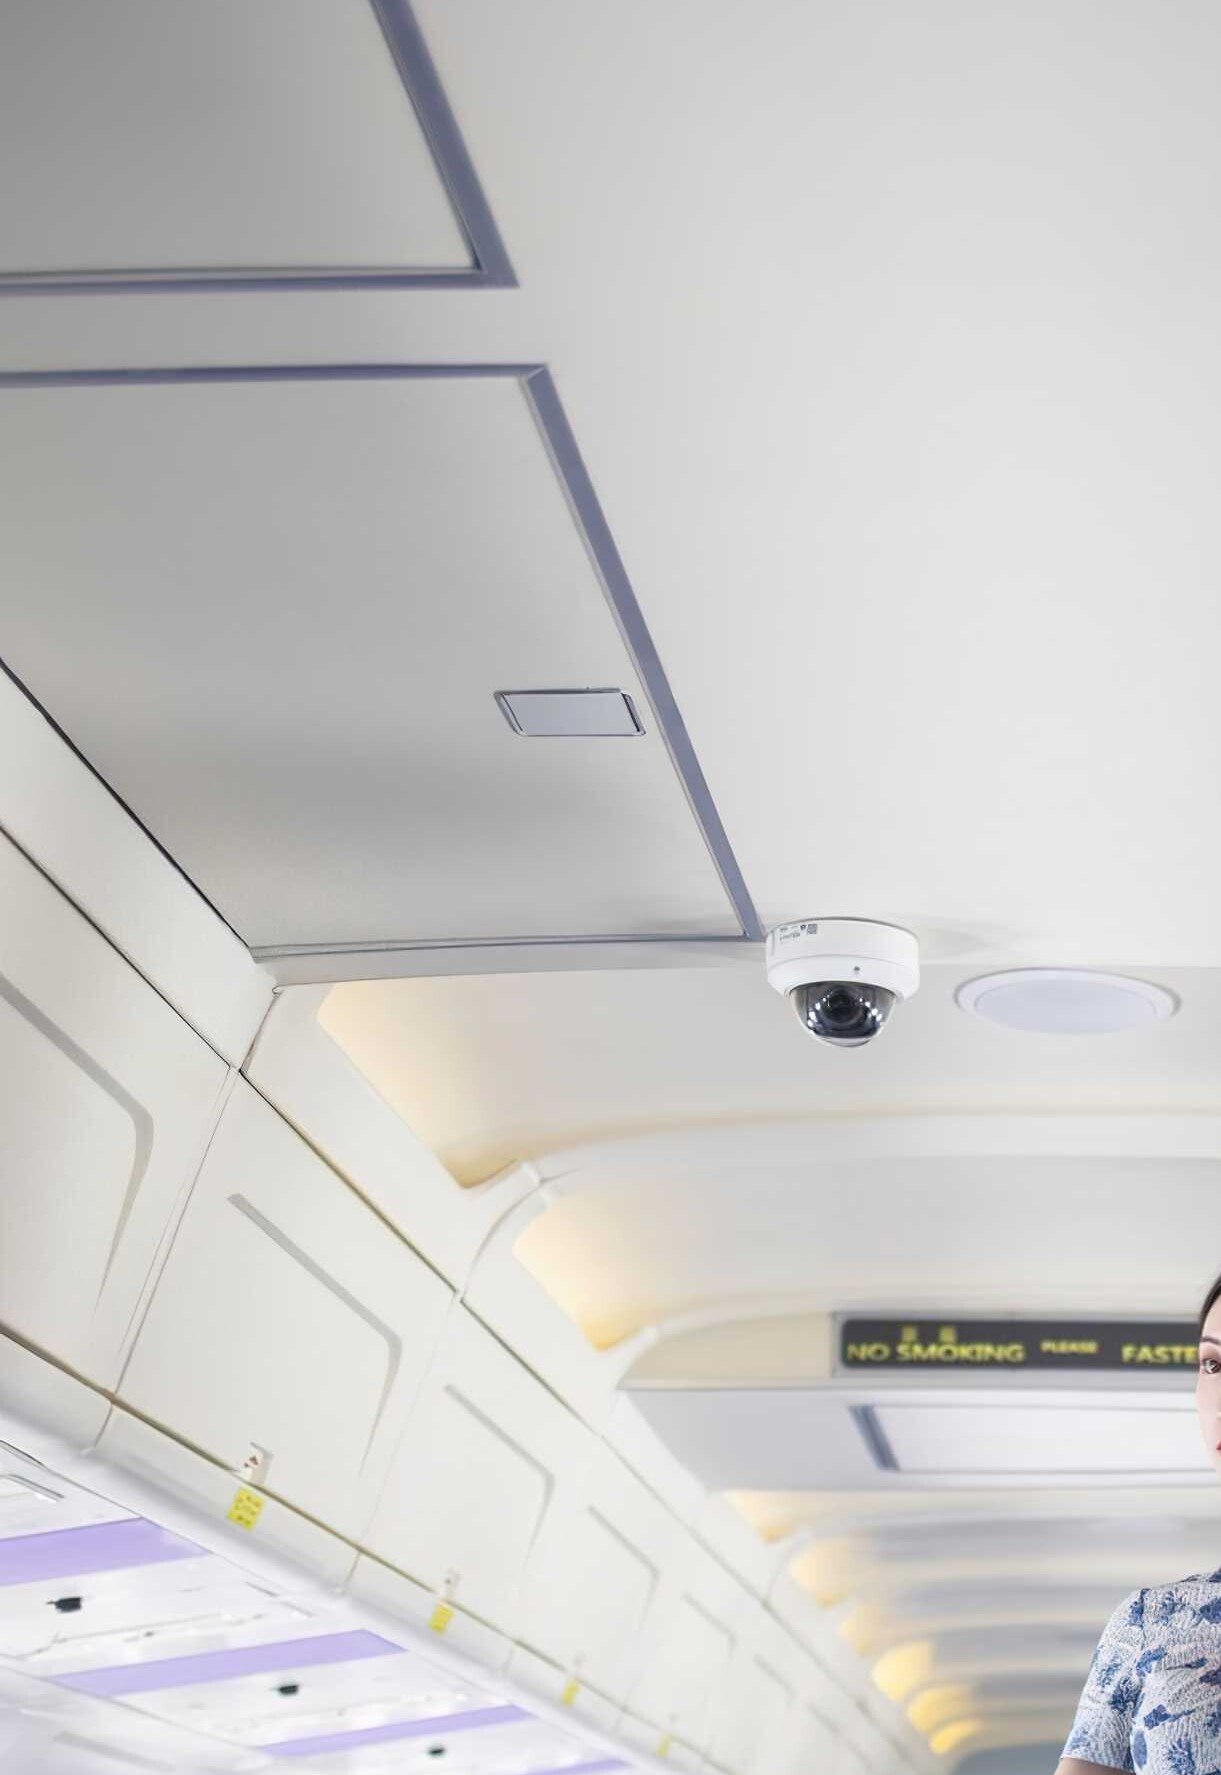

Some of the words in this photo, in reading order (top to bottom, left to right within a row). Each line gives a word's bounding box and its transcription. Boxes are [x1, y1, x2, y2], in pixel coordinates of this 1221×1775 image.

[847, 1343, 891, 1362] NO
[896, 1343, 1027, 1363] SMOKING
[1039, 1339, 1098, 1354] PLEASE
[1120, 1345, 1199, 1364] FASTE
